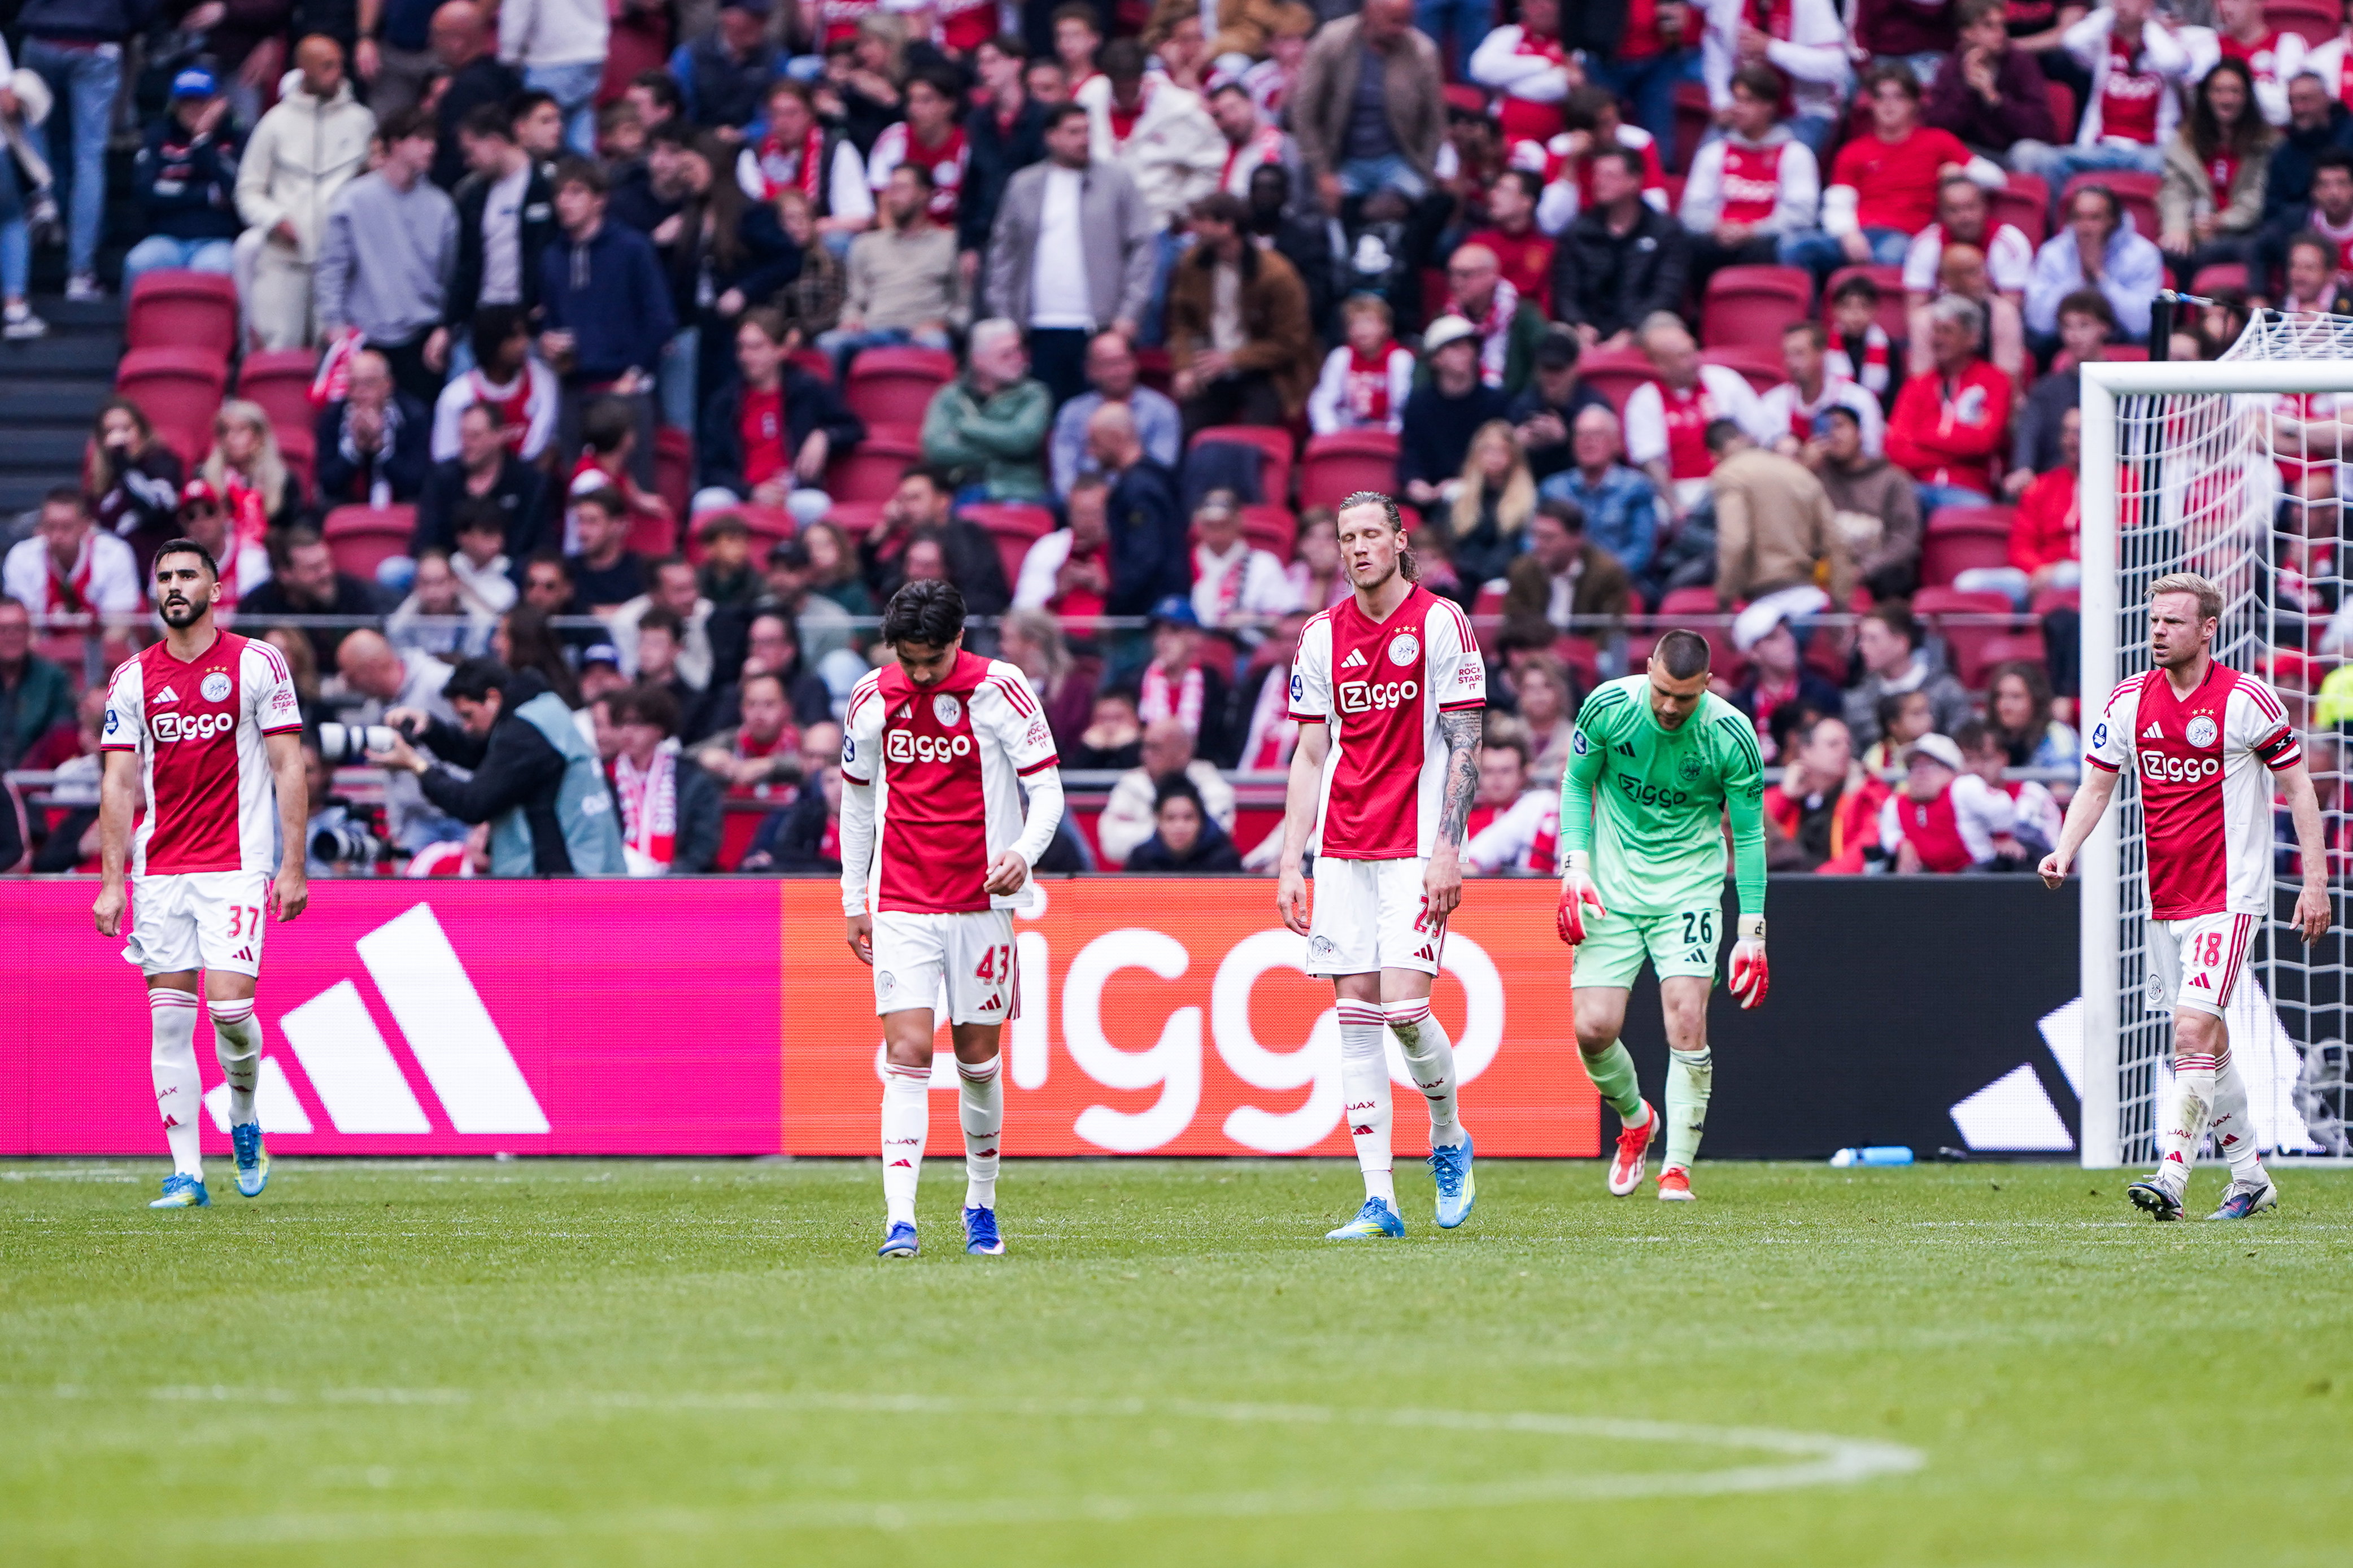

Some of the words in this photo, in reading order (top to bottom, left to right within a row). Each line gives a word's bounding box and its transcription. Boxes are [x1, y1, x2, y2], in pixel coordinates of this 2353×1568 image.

[1459, 667, 1481, 675] ROCK
[228, 905, 259, 940] 37
[1682, 911, 1712, 944] 26
[975, 944, 1010, 985] 43
[2193, 932, 2223, 968] 18
[156, 1086, 178, 1100] JAX
